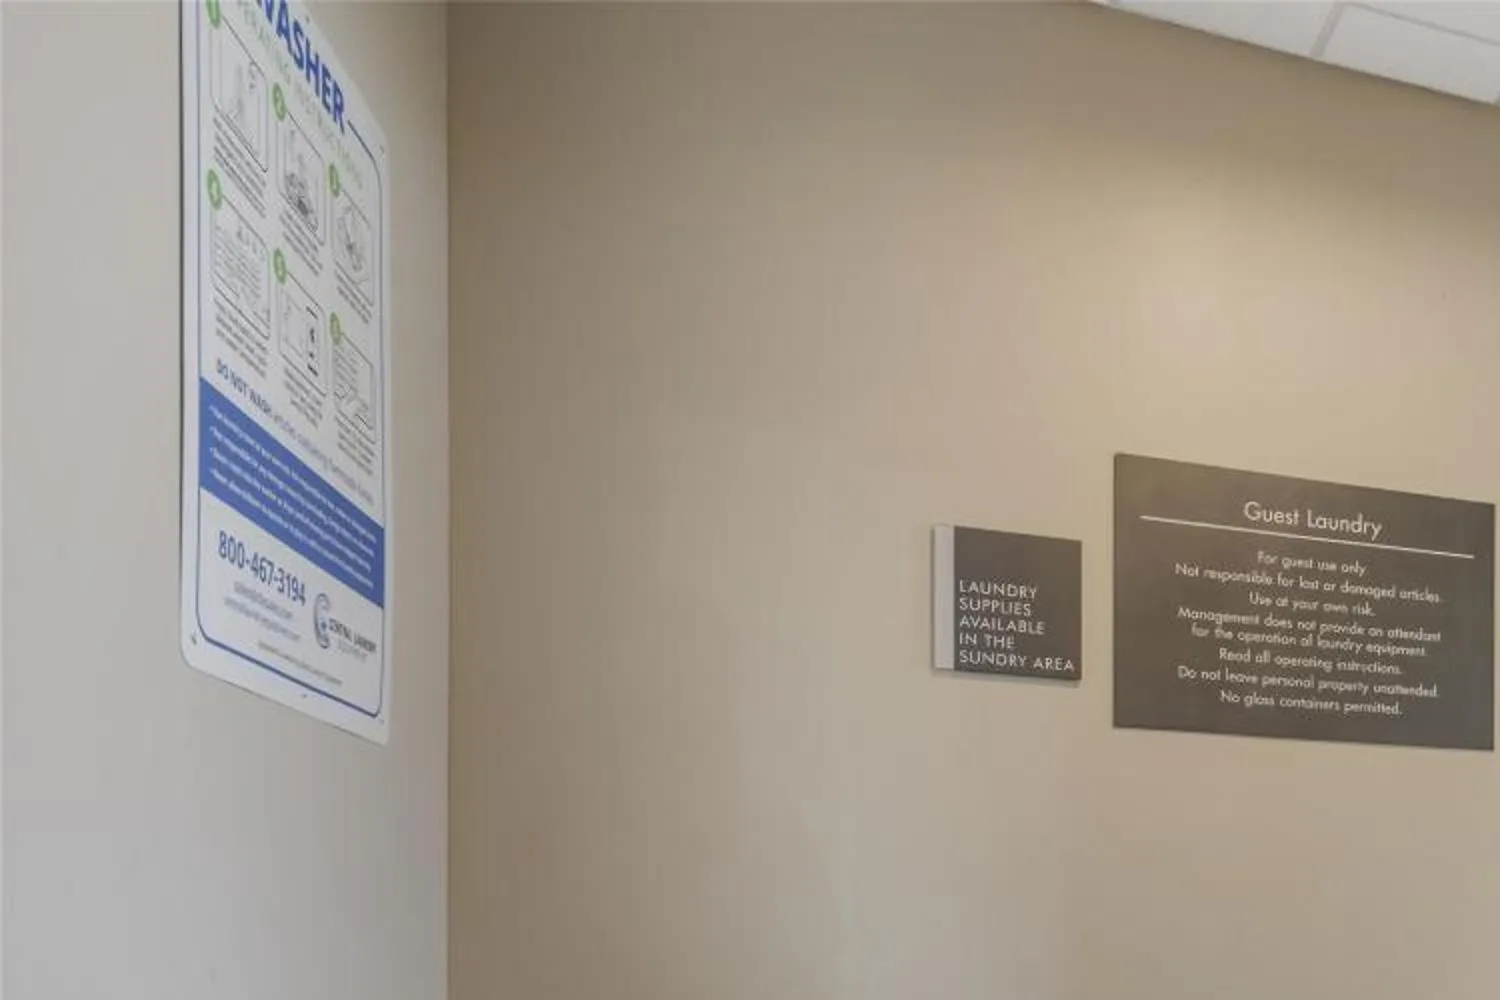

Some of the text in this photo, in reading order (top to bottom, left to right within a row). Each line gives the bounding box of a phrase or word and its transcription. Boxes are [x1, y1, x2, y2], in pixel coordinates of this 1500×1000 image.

[1243, 500, 1383, 541] Guest Laundry
[218, 530, 307, 607] 800-467-3194
[1257, 550, 1367, 577] For guest use only
[959, 580, 1037, 599] LAUNDRY
[1175, 562, 1200, 578] Not
[1202, 568, 1274, 586] responsible
[1277, 572, 1295, 588] for
[1299, 575, 1320, 589] lost
[1323, 581, 1337, 591] or
[1339, 580, 1396, 600] damaged
[959, 597, 1031, 617] SUPPLIES
[1249, 591, 1377, 617] Use at your own risk.
[959, 615, 1046, 635] AVAILABLE
[1177, 607, 1441, 642] Management does not provide an attendant
[1191, 621, 1209, 637] for
[1214, 626, 1234, 640] the
[1237, 630, 1297, 645] operation
[1300, 632, 1314, 647] of
[1317, 632, 1364, 655] laundry
[959, 633, 1016, 649] IN THE
[959, 649, 1075, 671] SUNDRY AREA
[1219, 647, 1403, 675] Read all operating instructions.
[1177, 665, 1197, 679] Do
[1201, 669, 1221, 681] not
[1225, 667, 1259, 684] leave
[1261, 674, 1315, 690] personal
[1317, 680, 1369, 697] property
[1220, 689, 1403, 716] No glass containers permitted.
